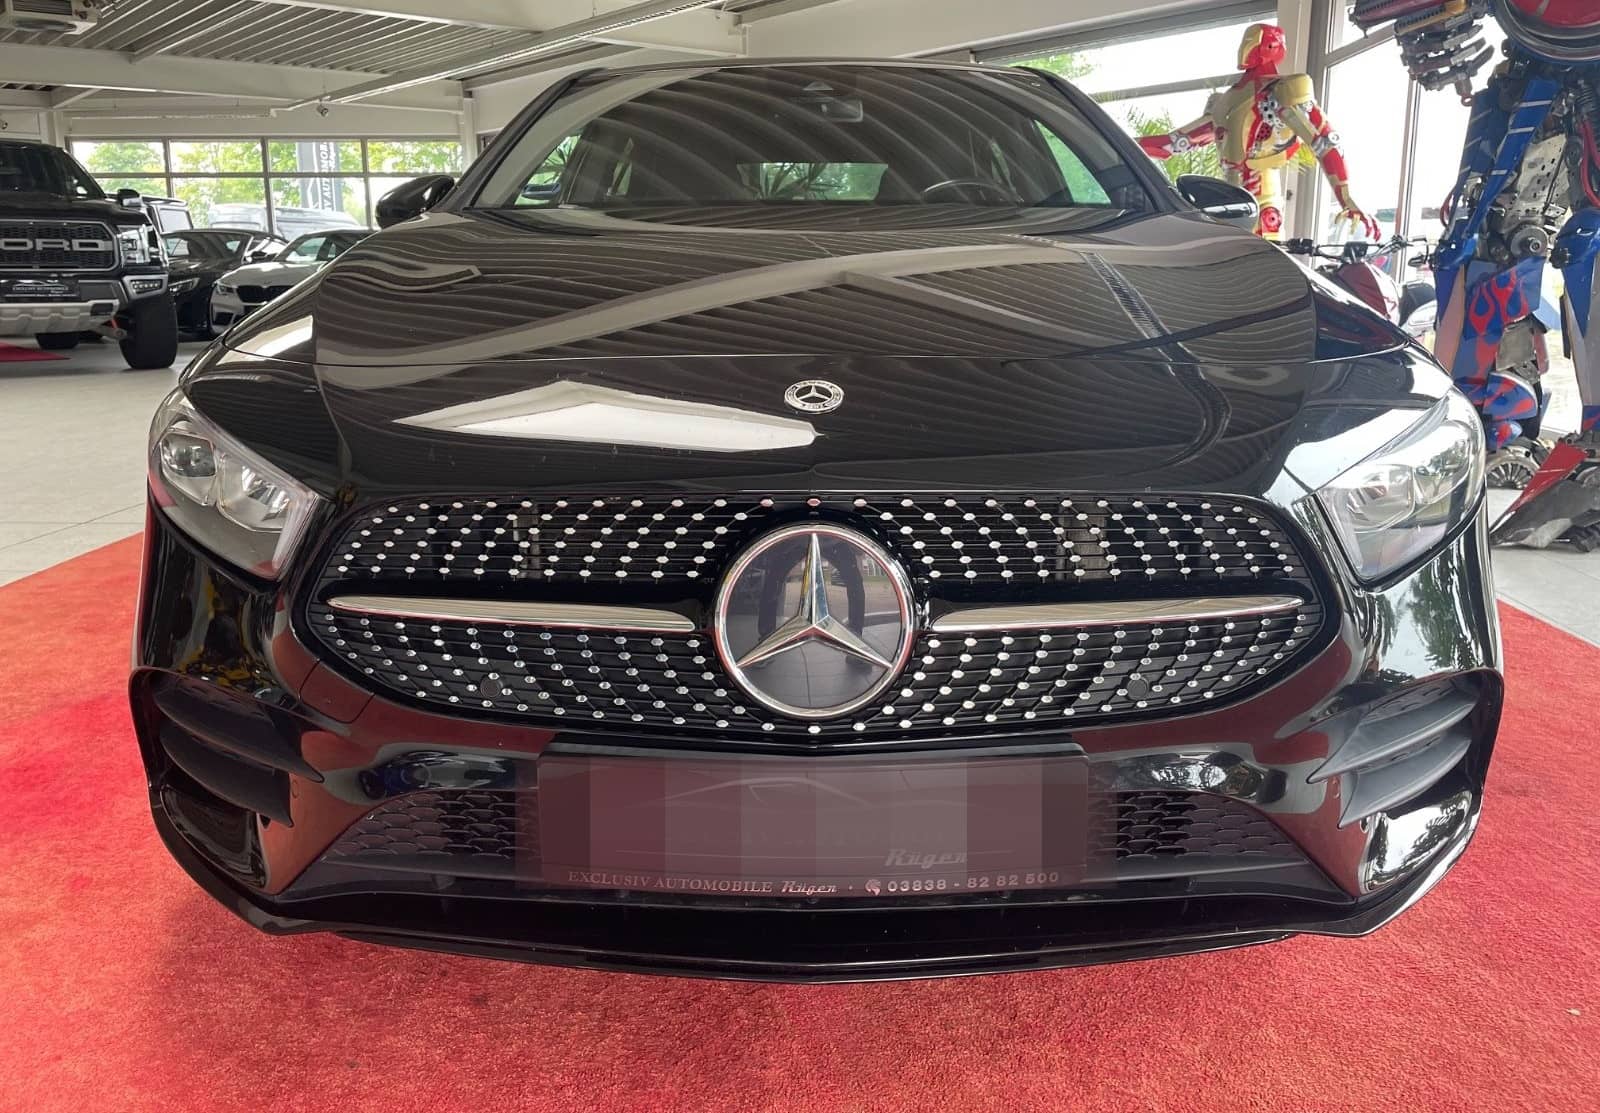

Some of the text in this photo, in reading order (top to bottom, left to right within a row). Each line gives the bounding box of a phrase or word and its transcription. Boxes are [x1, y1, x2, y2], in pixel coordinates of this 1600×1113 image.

[885, 849, 968, 869] Rügen
[568, 871, 651, 887] EXCLUSIV
[654, 879, 773, 893] AUTOMOBILE
[781, 880, 837, 895] Rügen
[887, 879, 947, 892] 03838
[967, 876, 990, 889] 82
[996, 874, 1019, 887] 82
[1025, 872, 1059, 884] 500
